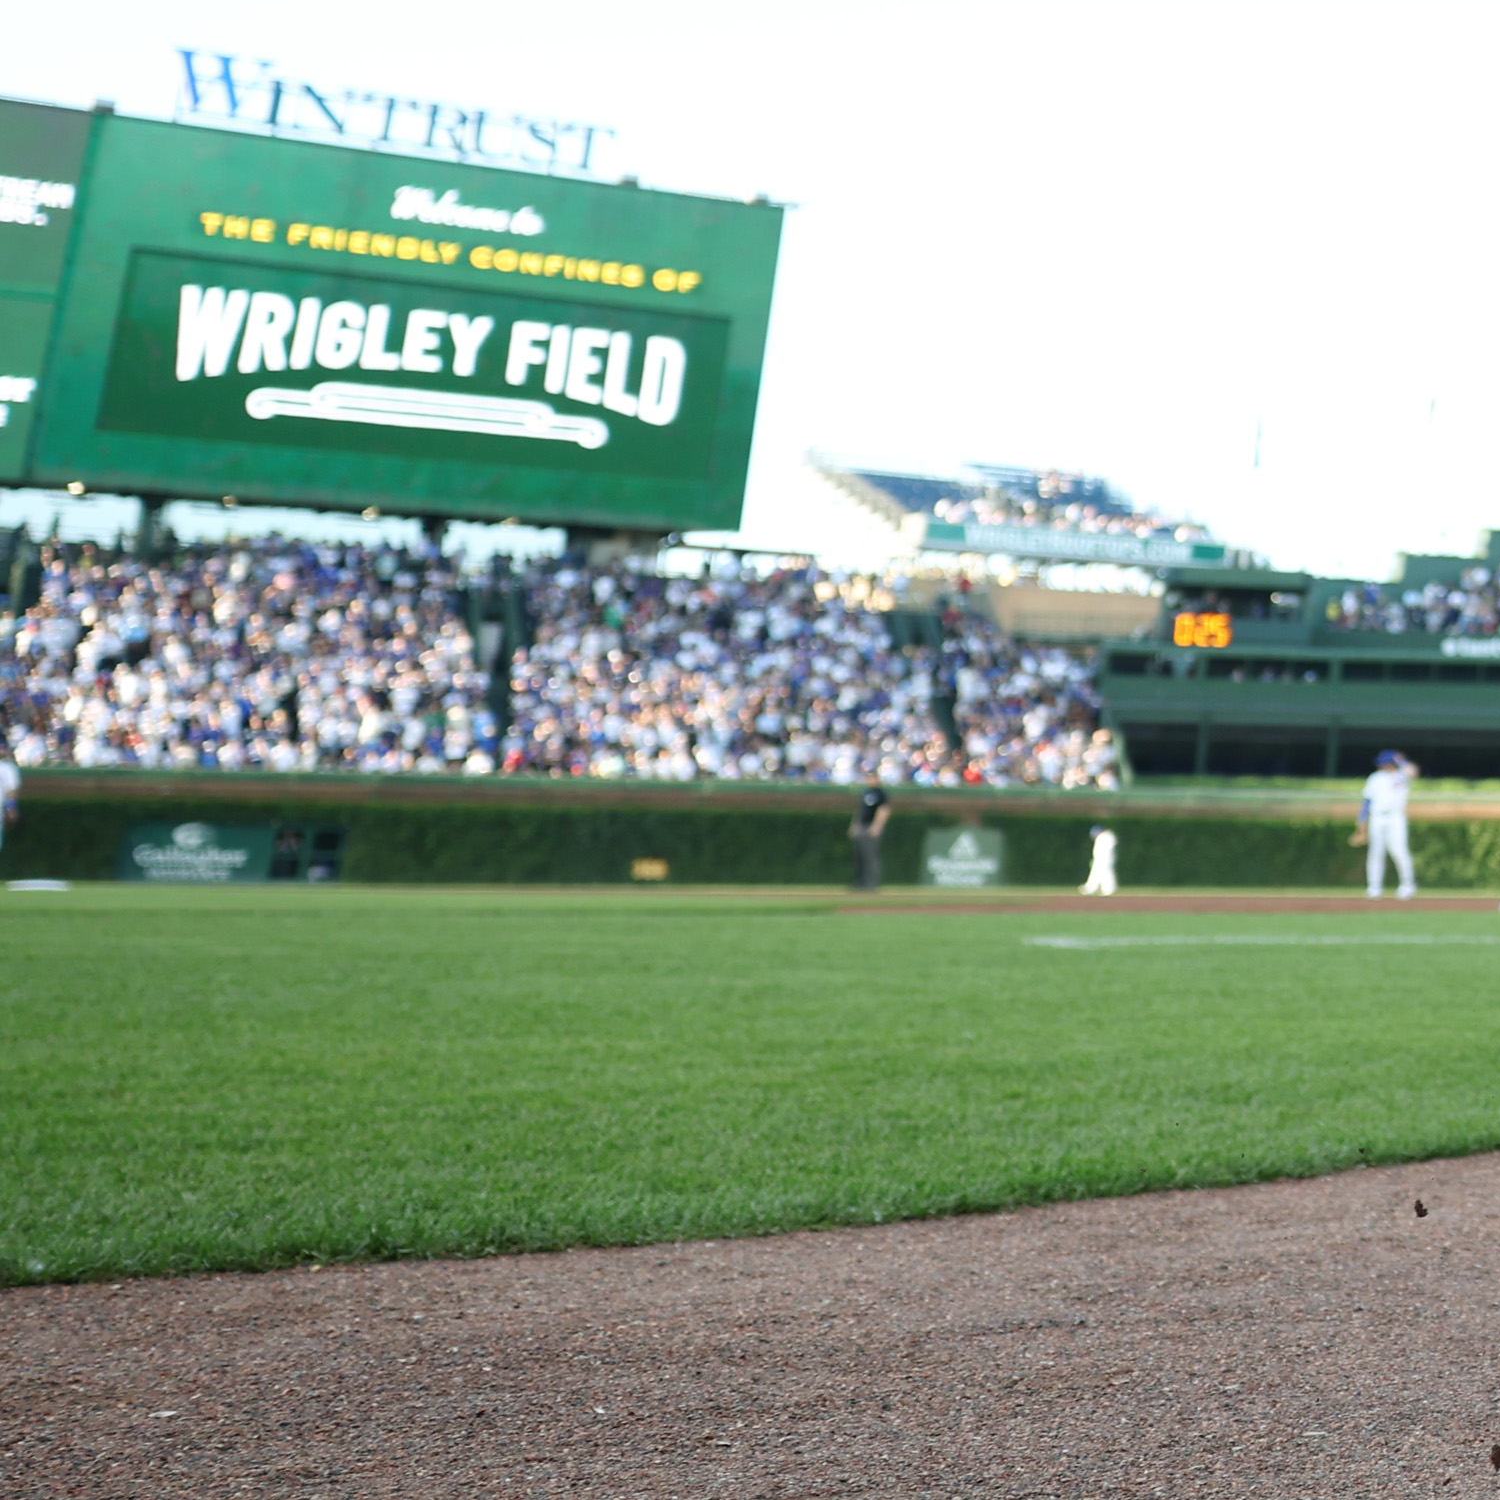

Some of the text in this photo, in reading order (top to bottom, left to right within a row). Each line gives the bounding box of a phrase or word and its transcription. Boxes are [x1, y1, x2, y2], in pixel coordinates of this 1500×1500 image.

[173, 47, 617, 170] WINTRUST
[200, 211, 702, 295] THE FRIENDLY CONFINES OF
[389, 185, 510, 233] Welcome
[175, 283, 688, 427] WRIGLEY FIELD
